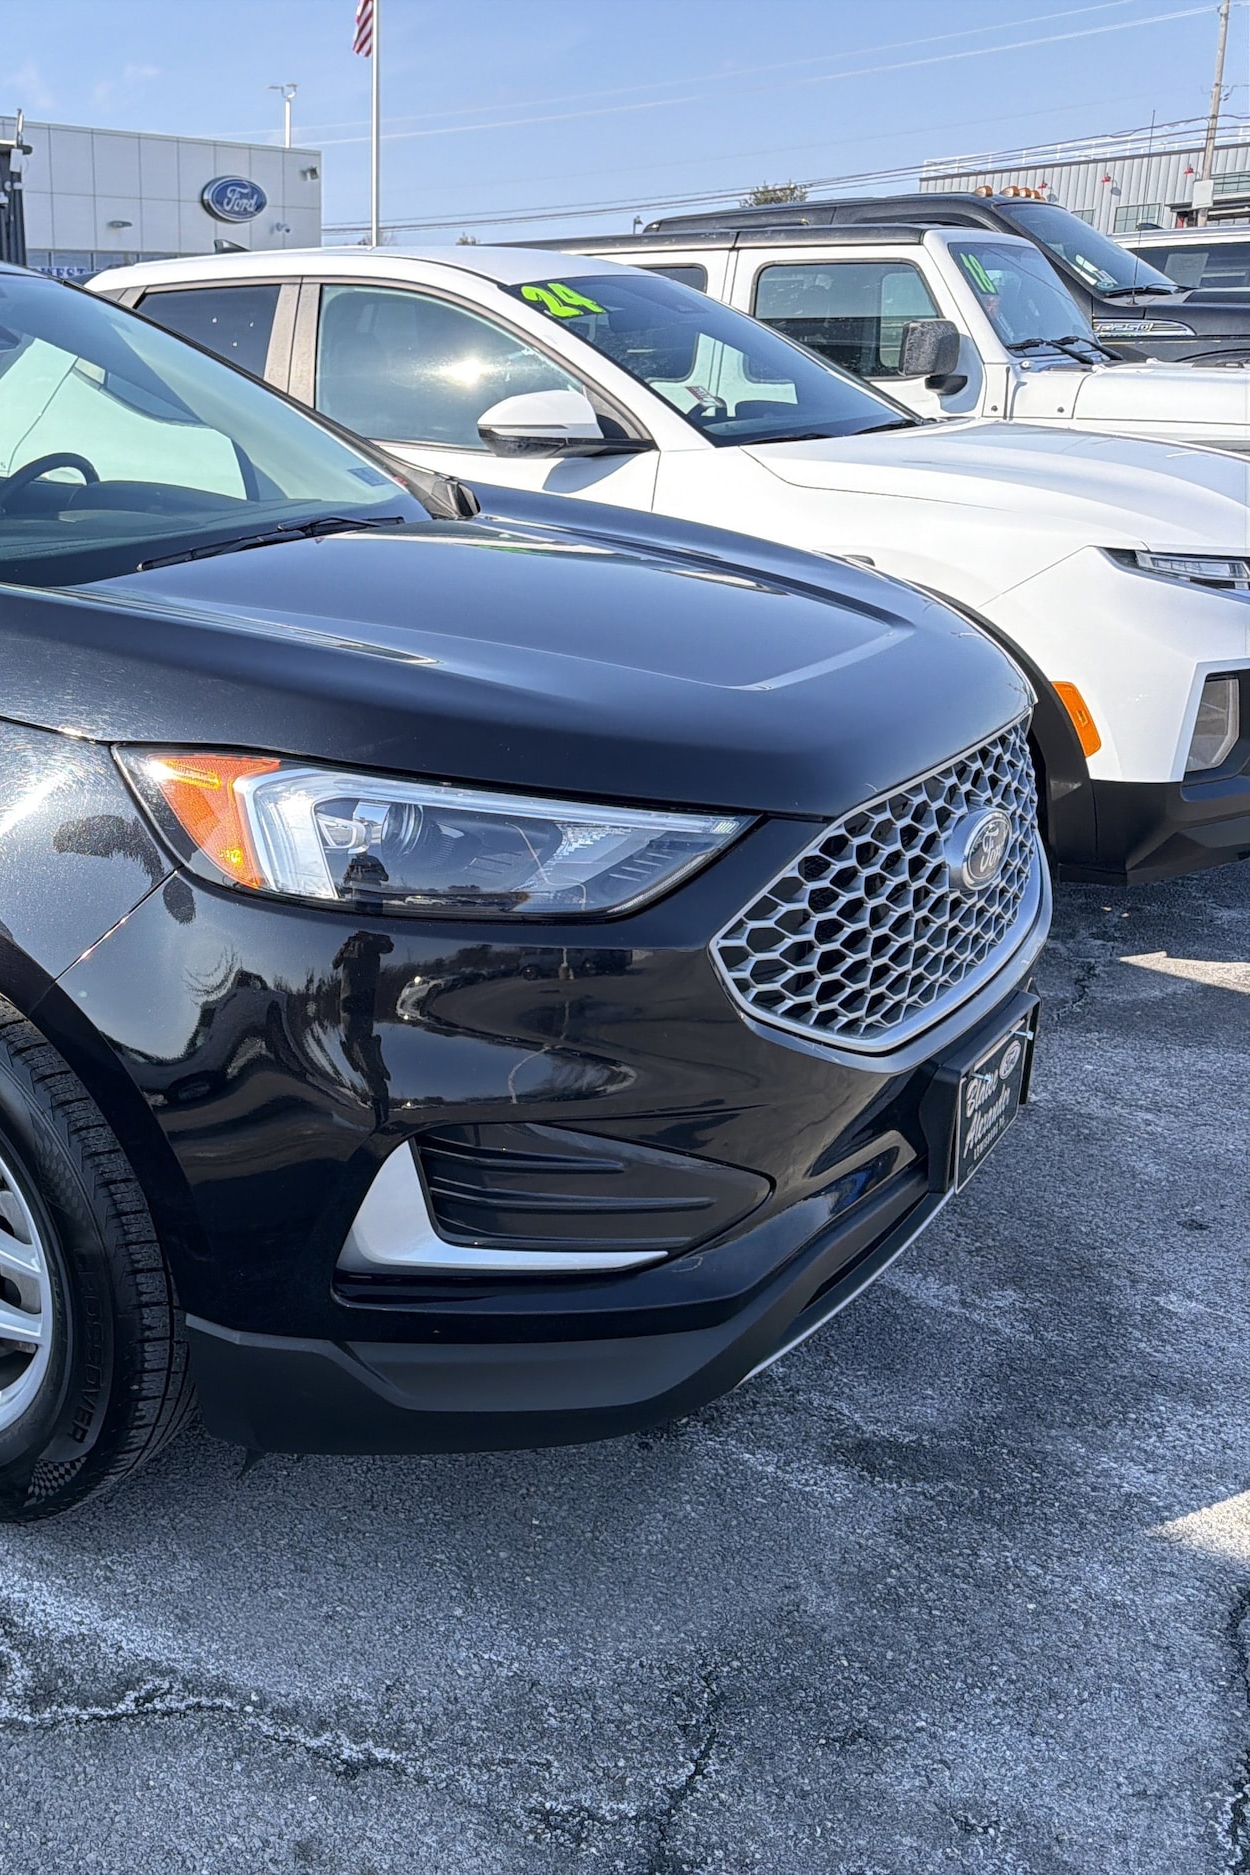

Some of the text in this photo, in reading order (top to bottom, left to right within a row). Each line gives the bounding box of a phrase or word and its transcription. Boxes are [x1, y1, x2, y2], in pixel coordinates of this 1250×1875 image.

[223, 183, 258, 212] Ford
[959, 253, 997, 293] 18
[521, 283, 606, 317] 24
[980, 824, 1008, 873] Ford
